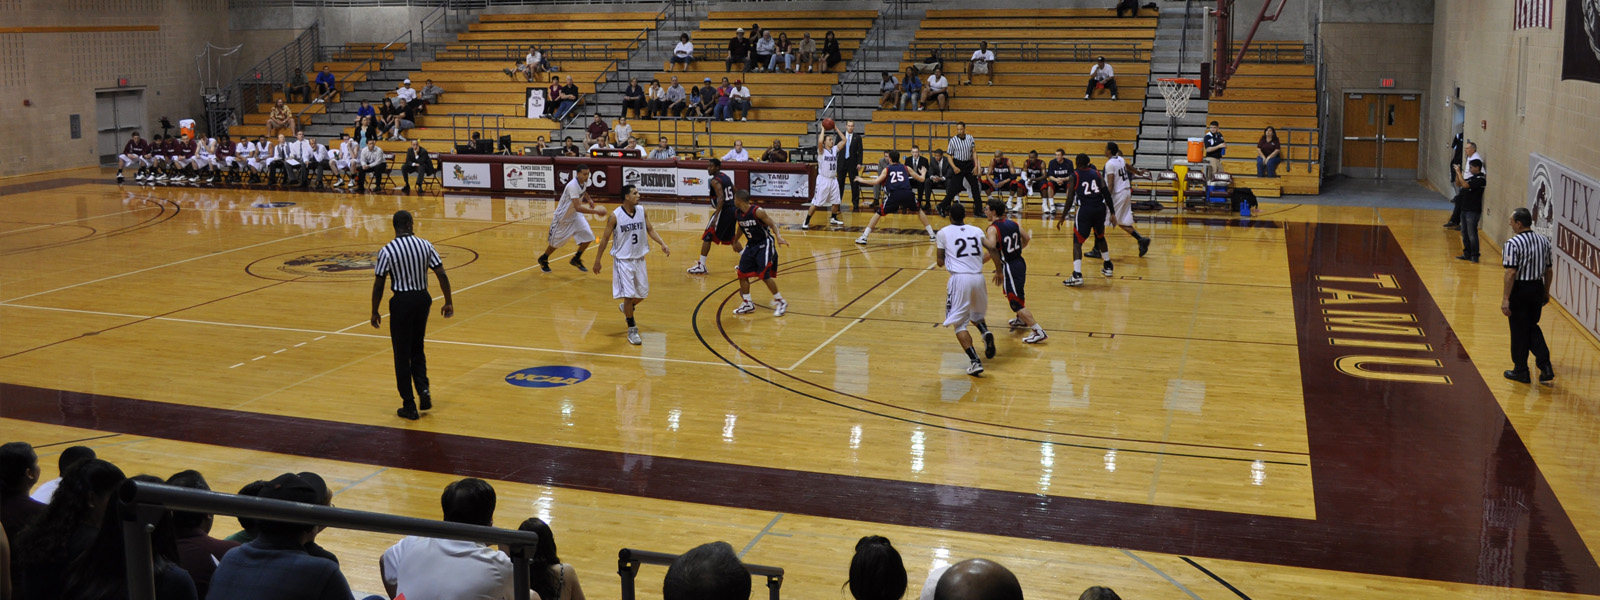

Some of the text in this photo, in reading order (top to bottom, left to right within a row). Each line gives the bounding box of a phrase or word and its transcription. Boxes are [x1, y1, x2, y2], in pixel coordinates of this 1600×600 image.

[829, 163, 836, 171] 10
[641, 173, 675, 188] DUSTDEVILS
[889, 171, 905, 183] 25
[724, 186, 734, 201] 15
[1082, 179, 1100, 195] 24
[632, 233, 638, 245] 3
[744, 228, 752, 239] 5
[954, 236, 980, 258] 23
[1004, 232, 1020, 253] 22
[1315, 273, 1453, 385] TAMIU
[506, 373, 580, 385] NCAA
